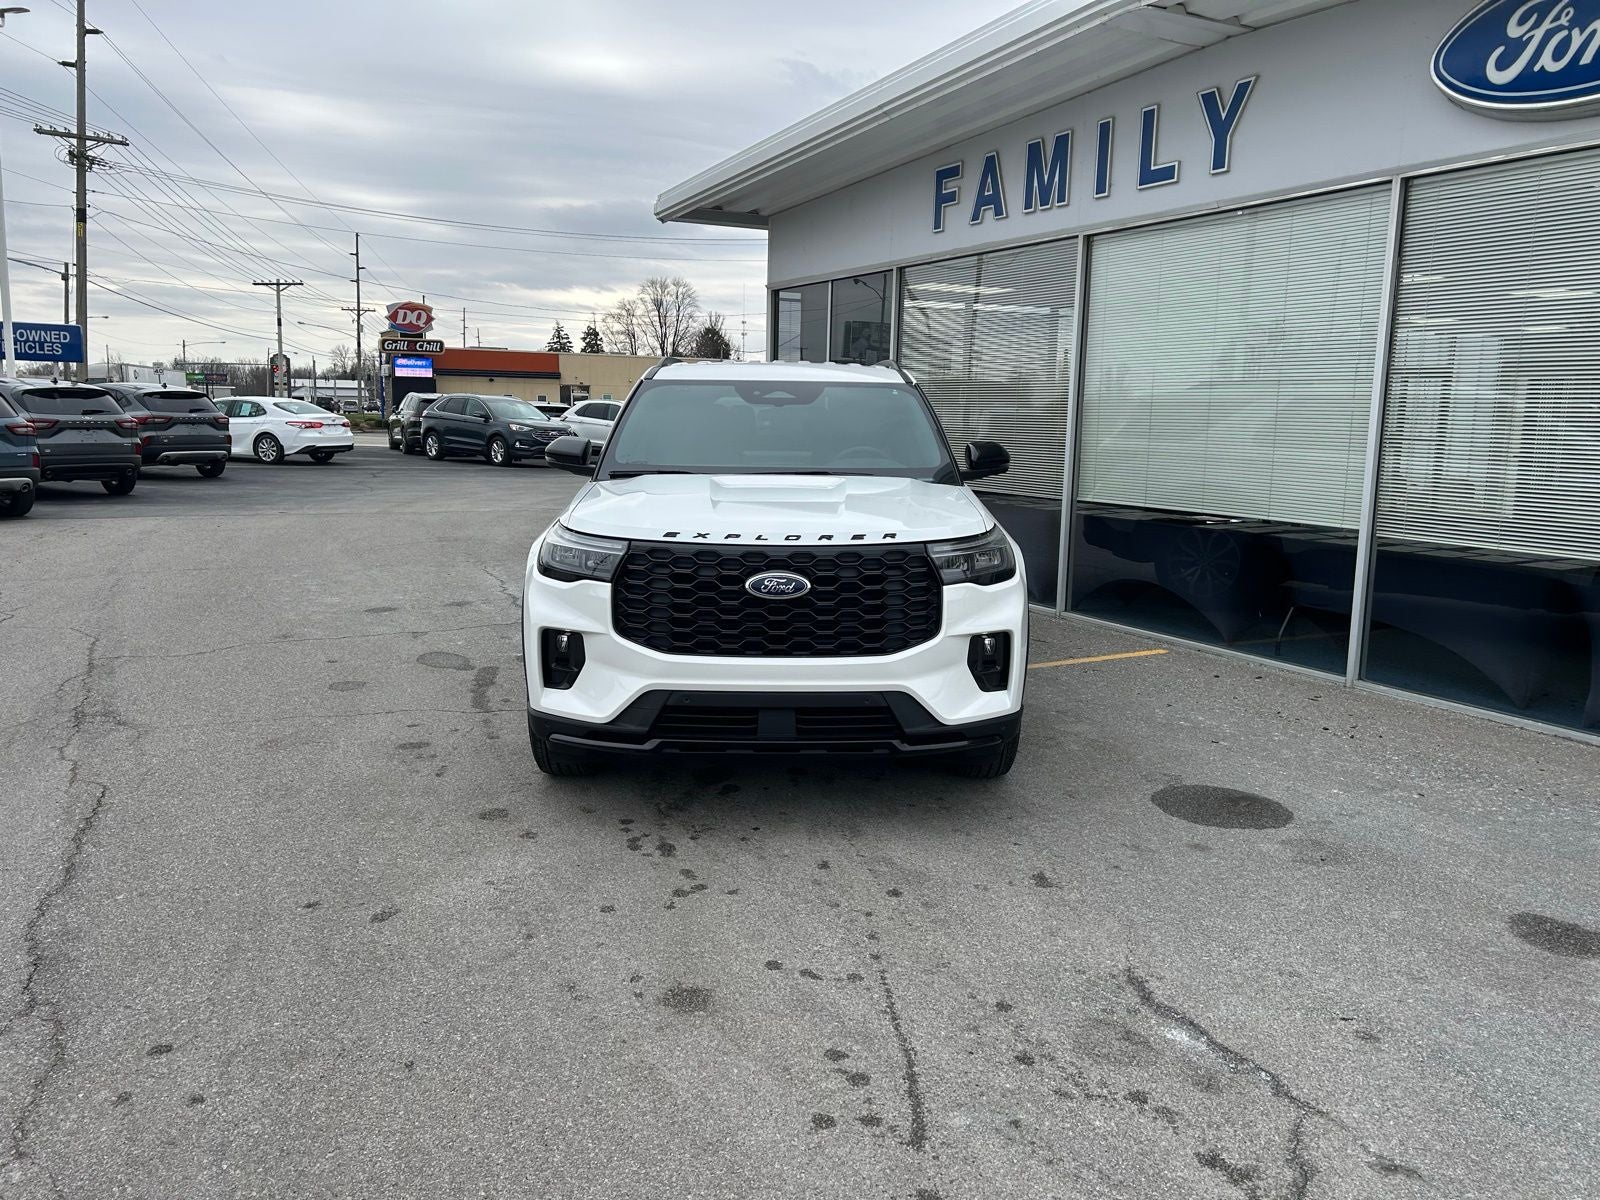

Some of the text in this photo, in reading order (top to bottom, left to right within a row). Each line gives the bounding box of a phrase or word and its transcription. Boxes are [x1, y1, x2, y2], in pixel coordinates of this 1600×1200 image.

[1486, 0, 1600, 85] For
[931, 75, 1258, 233] FAMILY
[396, 309, 427, 327] DQ
[384, 341, 440, 351] Grill & Chill
[662, 531, 897, 541] EXPLORER
[761, 578, 795, 592] Ford
